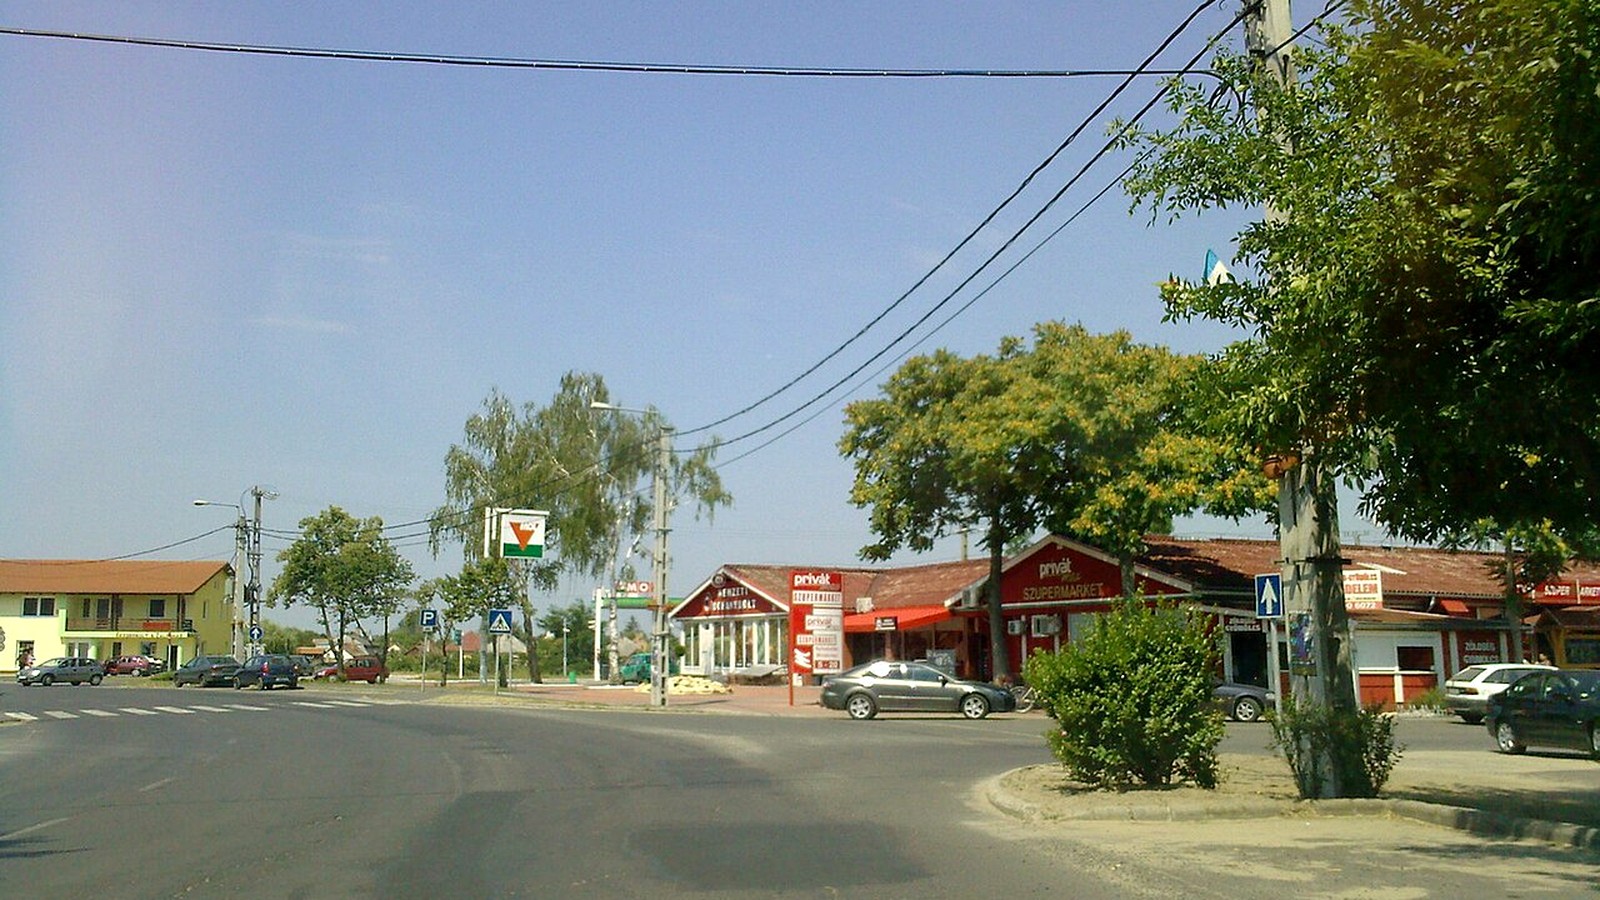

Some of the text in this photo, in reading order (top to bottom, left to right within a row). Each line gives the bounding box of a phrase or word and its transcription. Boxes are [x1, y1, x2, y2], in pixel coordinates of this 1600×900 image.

[1039, 558, 1072, 579] privát
[794, 573, 831, 586] privát
[794, 592, 841, 602] SZUPERMARKET
[1023, 583, 1104, 600] SZUPERMARKET
[422, 613, 434, 625] P
